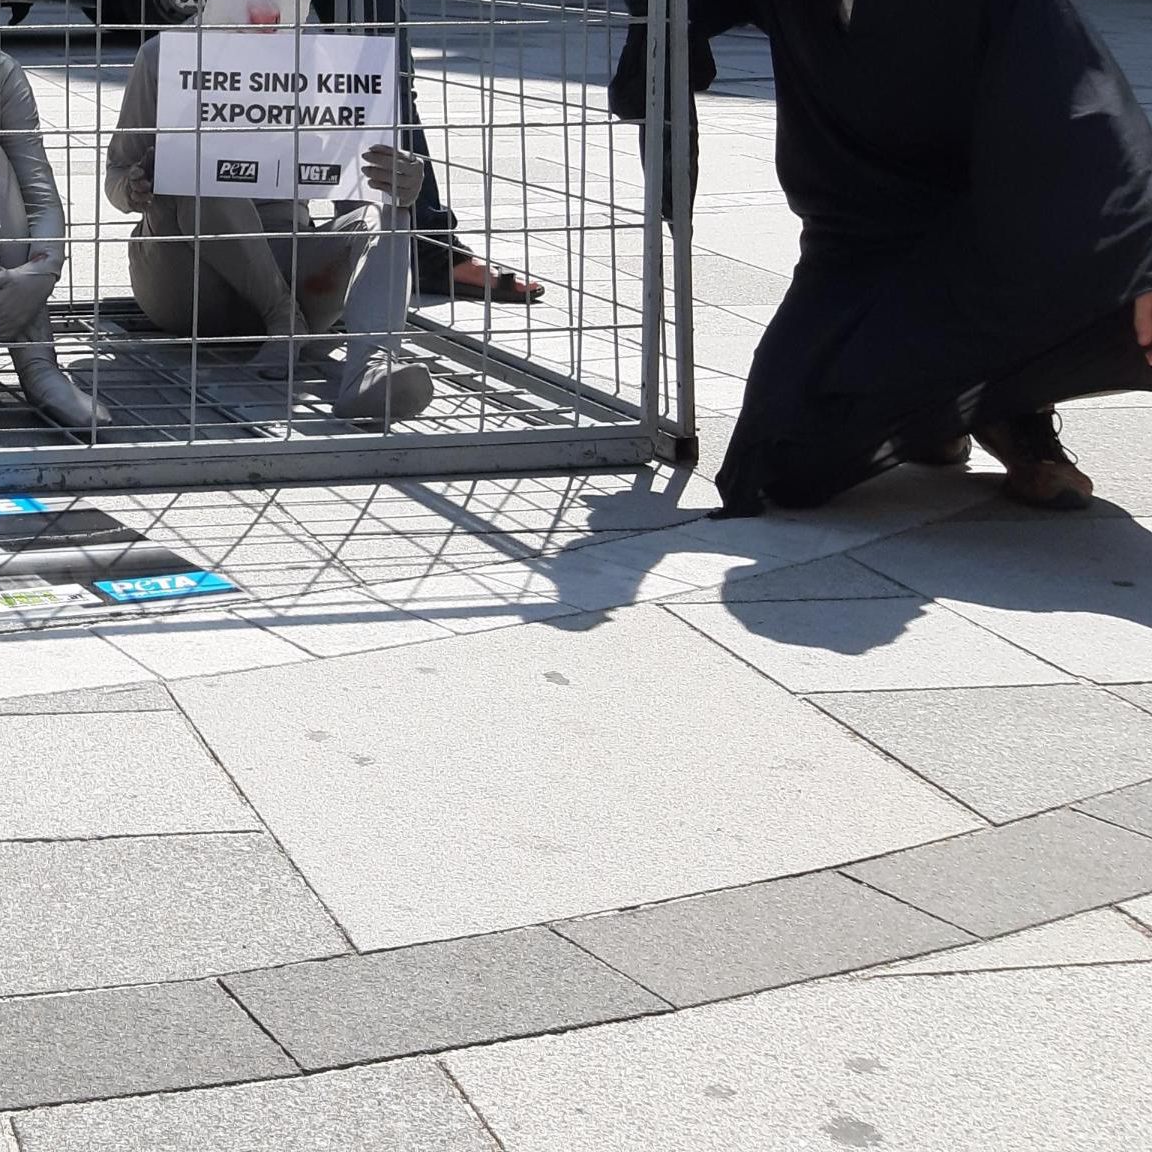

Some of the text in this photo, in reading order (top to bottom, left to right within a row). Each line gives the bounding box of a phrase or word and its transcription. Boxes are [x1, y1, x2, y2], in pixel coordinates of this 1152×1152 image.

[179, 70, 382, 95] TIERE SIND KEINE
[200, 102, 366, 126] EXPORTWARE
